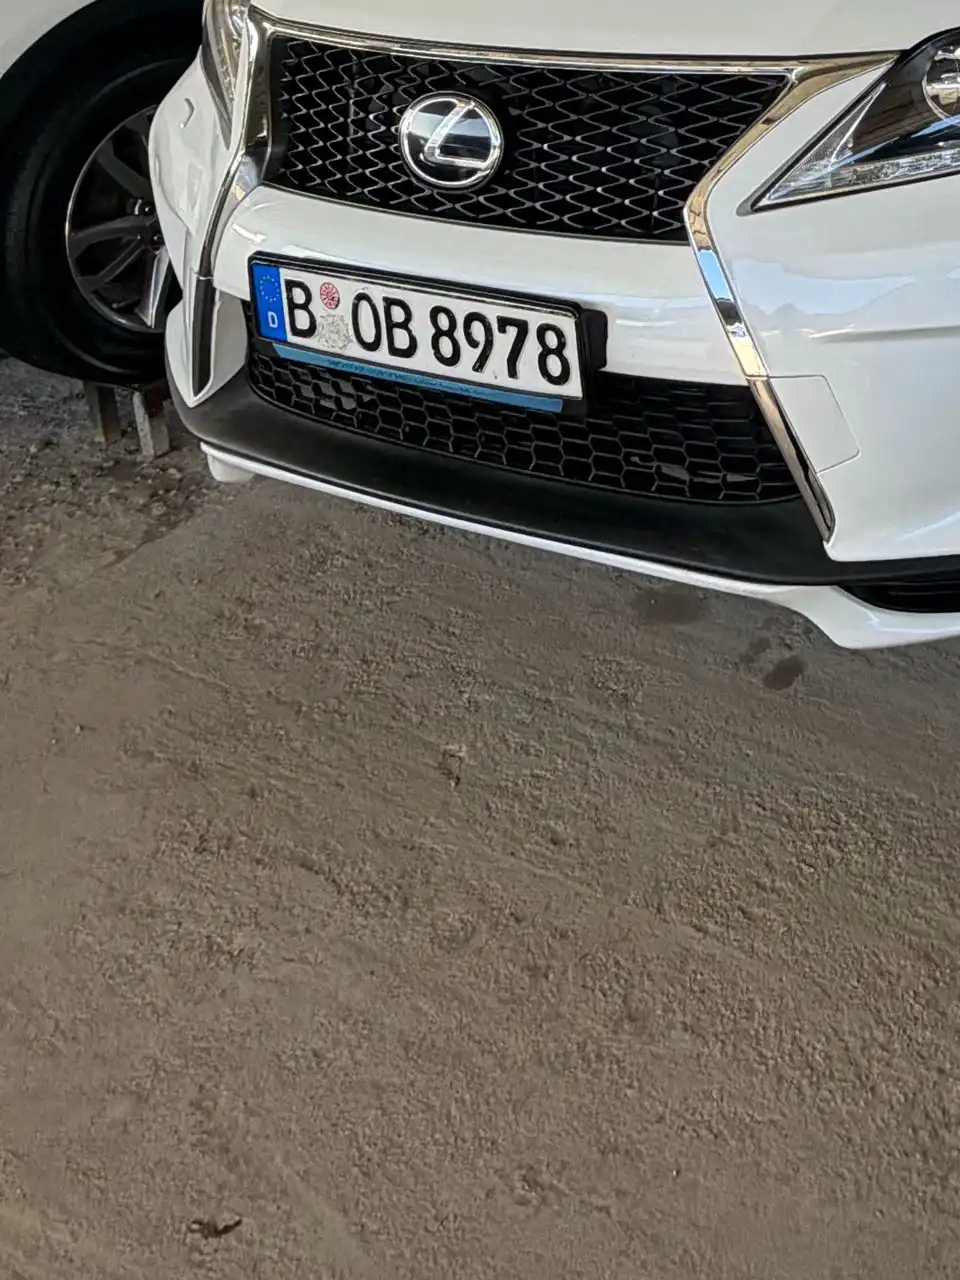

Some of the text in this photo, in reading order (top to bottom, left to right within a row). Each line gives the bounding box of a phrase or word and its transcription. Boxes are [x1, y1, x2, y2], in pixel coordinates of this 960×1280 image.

[267, 311, 279, 328] D
[284, 278, 318, 338] B
[429, 305, 571, 387] 8978
